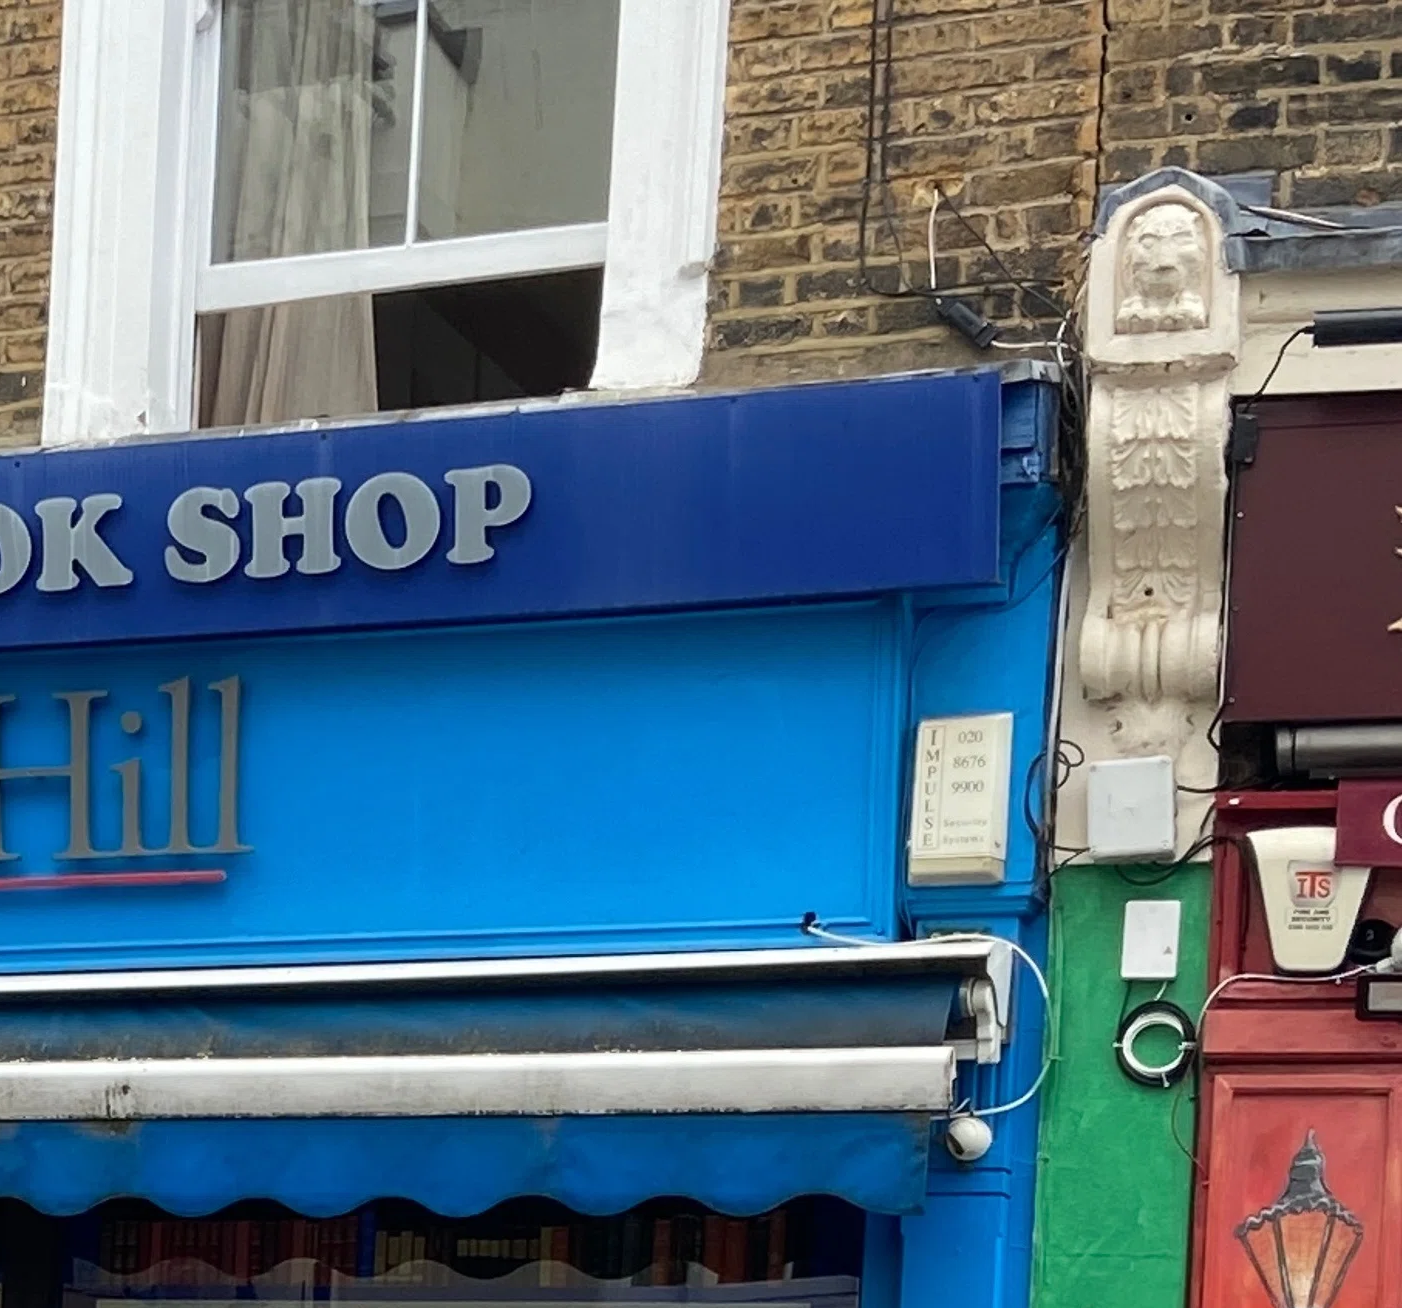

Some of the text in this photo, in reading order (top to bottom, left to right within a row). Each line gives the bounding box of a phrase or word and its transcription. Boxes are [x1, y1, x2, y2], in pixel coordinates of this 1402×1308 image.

[164, 464, 532, 583] SHOP
[958, 730, 984, 744] 020
[952, 755, 987, 769] 8676
[922, 729, 940, 847] IMPULSE
[951, 780, 985, 795] 9900
[1295, 871, 1333, 898] ITS
